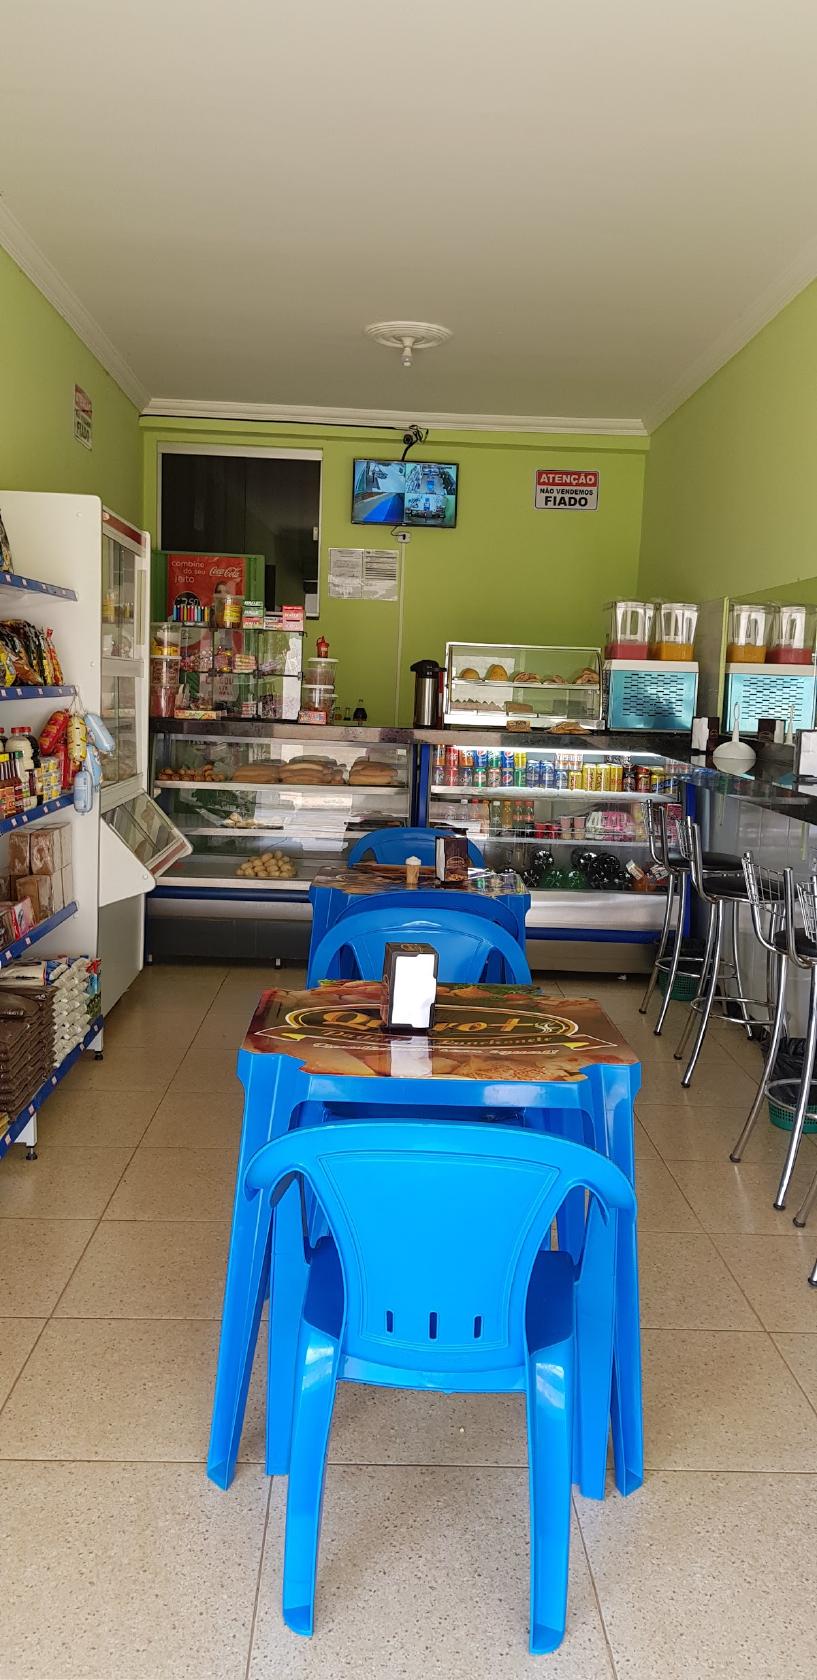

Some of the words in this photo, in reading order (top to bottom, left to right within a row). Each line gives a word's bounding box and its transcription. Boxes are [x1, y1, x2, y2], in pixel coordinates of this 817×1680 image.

[540, 473, 595, 486] ATENÇÃO
[556, 488, 593, 496] VENDEMOS
[544, 496, 588, 507] FIADO
[171, 560, 205, 568] combine
